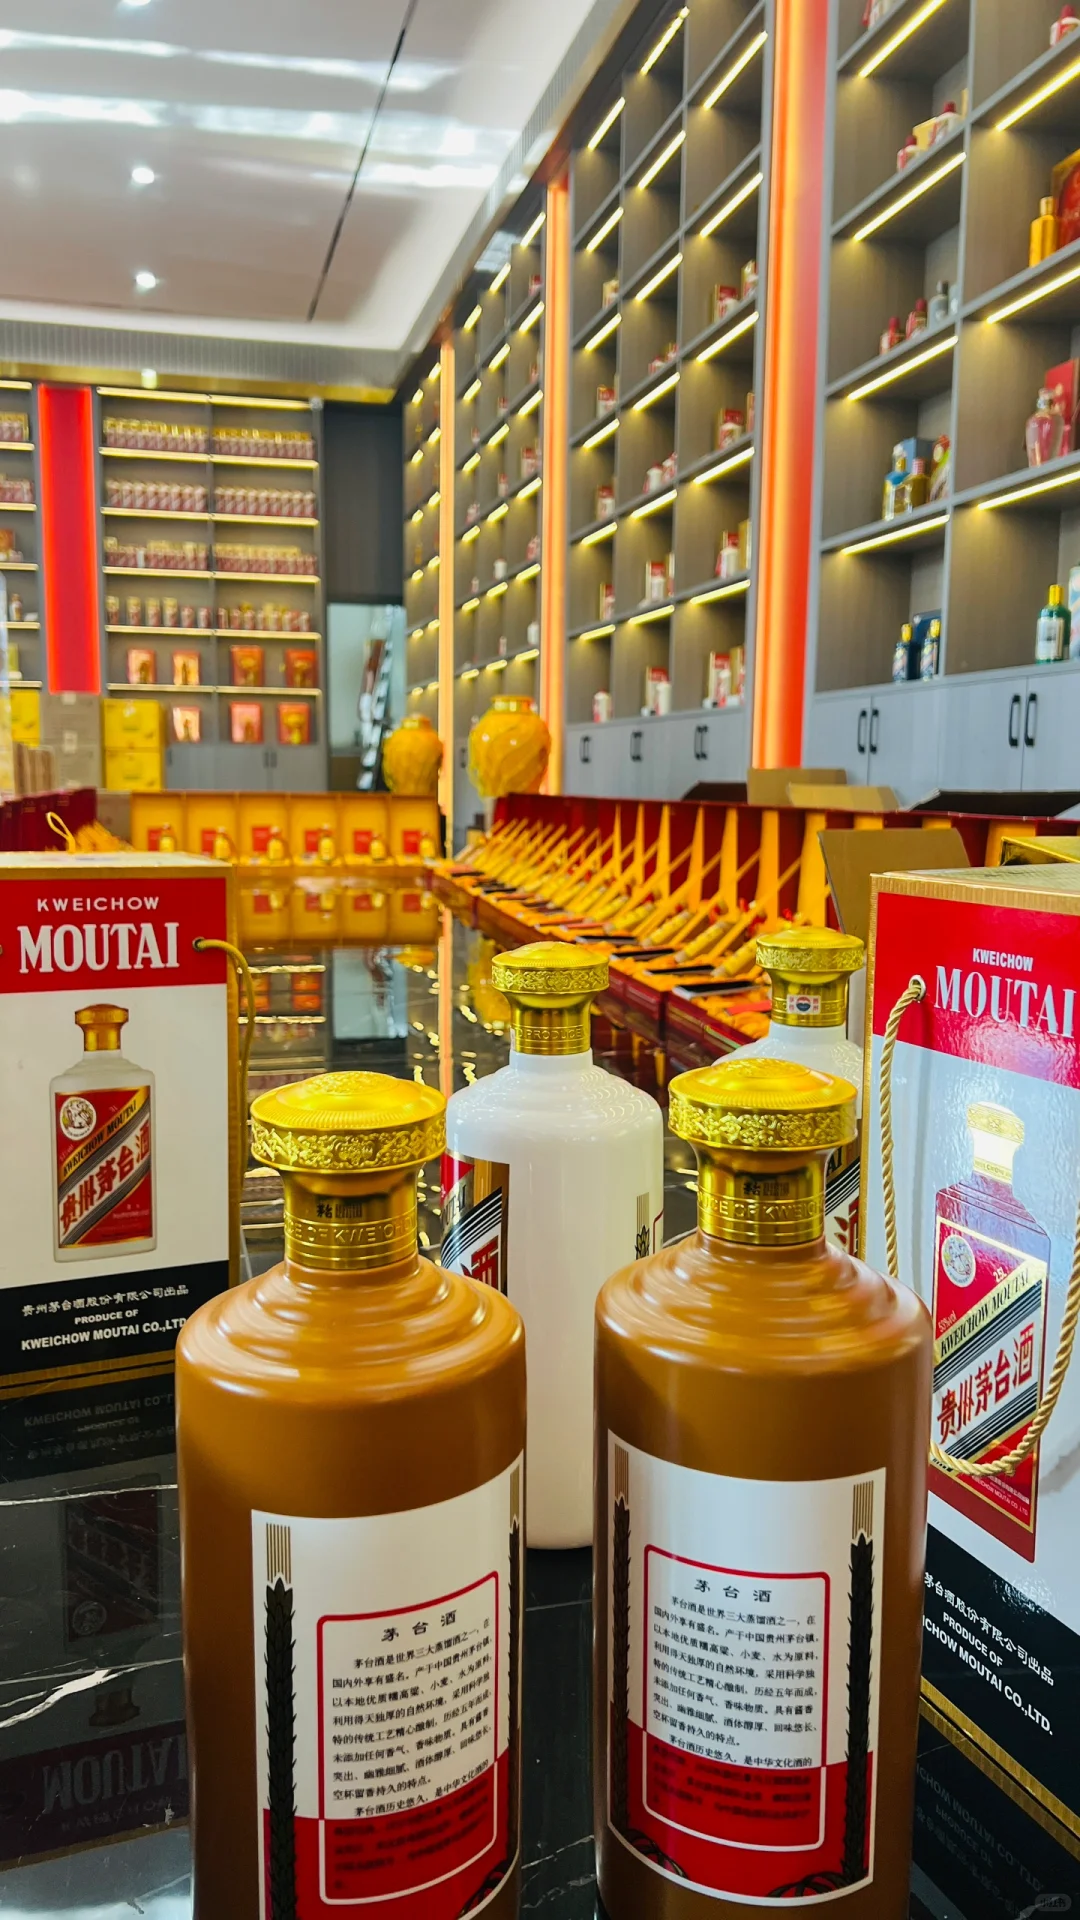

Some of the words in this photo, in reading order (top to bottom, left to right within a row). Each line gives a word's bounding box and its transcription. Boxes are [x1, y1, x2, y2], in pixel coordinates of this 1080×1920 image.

[38, 896, 159, 912] KWEICHOW
[17, 922, 180, 974] MOUTAI
[973, 948, 1033, 972] KWEICHOW
[934, 965, 1077, 1039] MOUTAI
[74, 1311, 122, 1324] PRODUCE
[125, 1309, 138, 1318] OF
[940, 1304, 990, 1359] KWEICHOW
[990, 1267, 1030, 1315] MOUTAI
[21, 1331, 90, 1350] KWEICHOW
[93, 1324, 140, 1340] MOUTAI
[936, 1322, 1035, 1444] 贵州茅台酒
[694, 1579, 772, 1602] 茅台酒
[382, 1610, 457, 1642] 茅台酒
[943, 1612, 988, 1657] PRODUCE
[989, 1650, 1004, 1668] OF
[958, 1646, 1002, 1692] MOUTAI
[1004, 1684, 1053, 1736] CO.,LTD.
